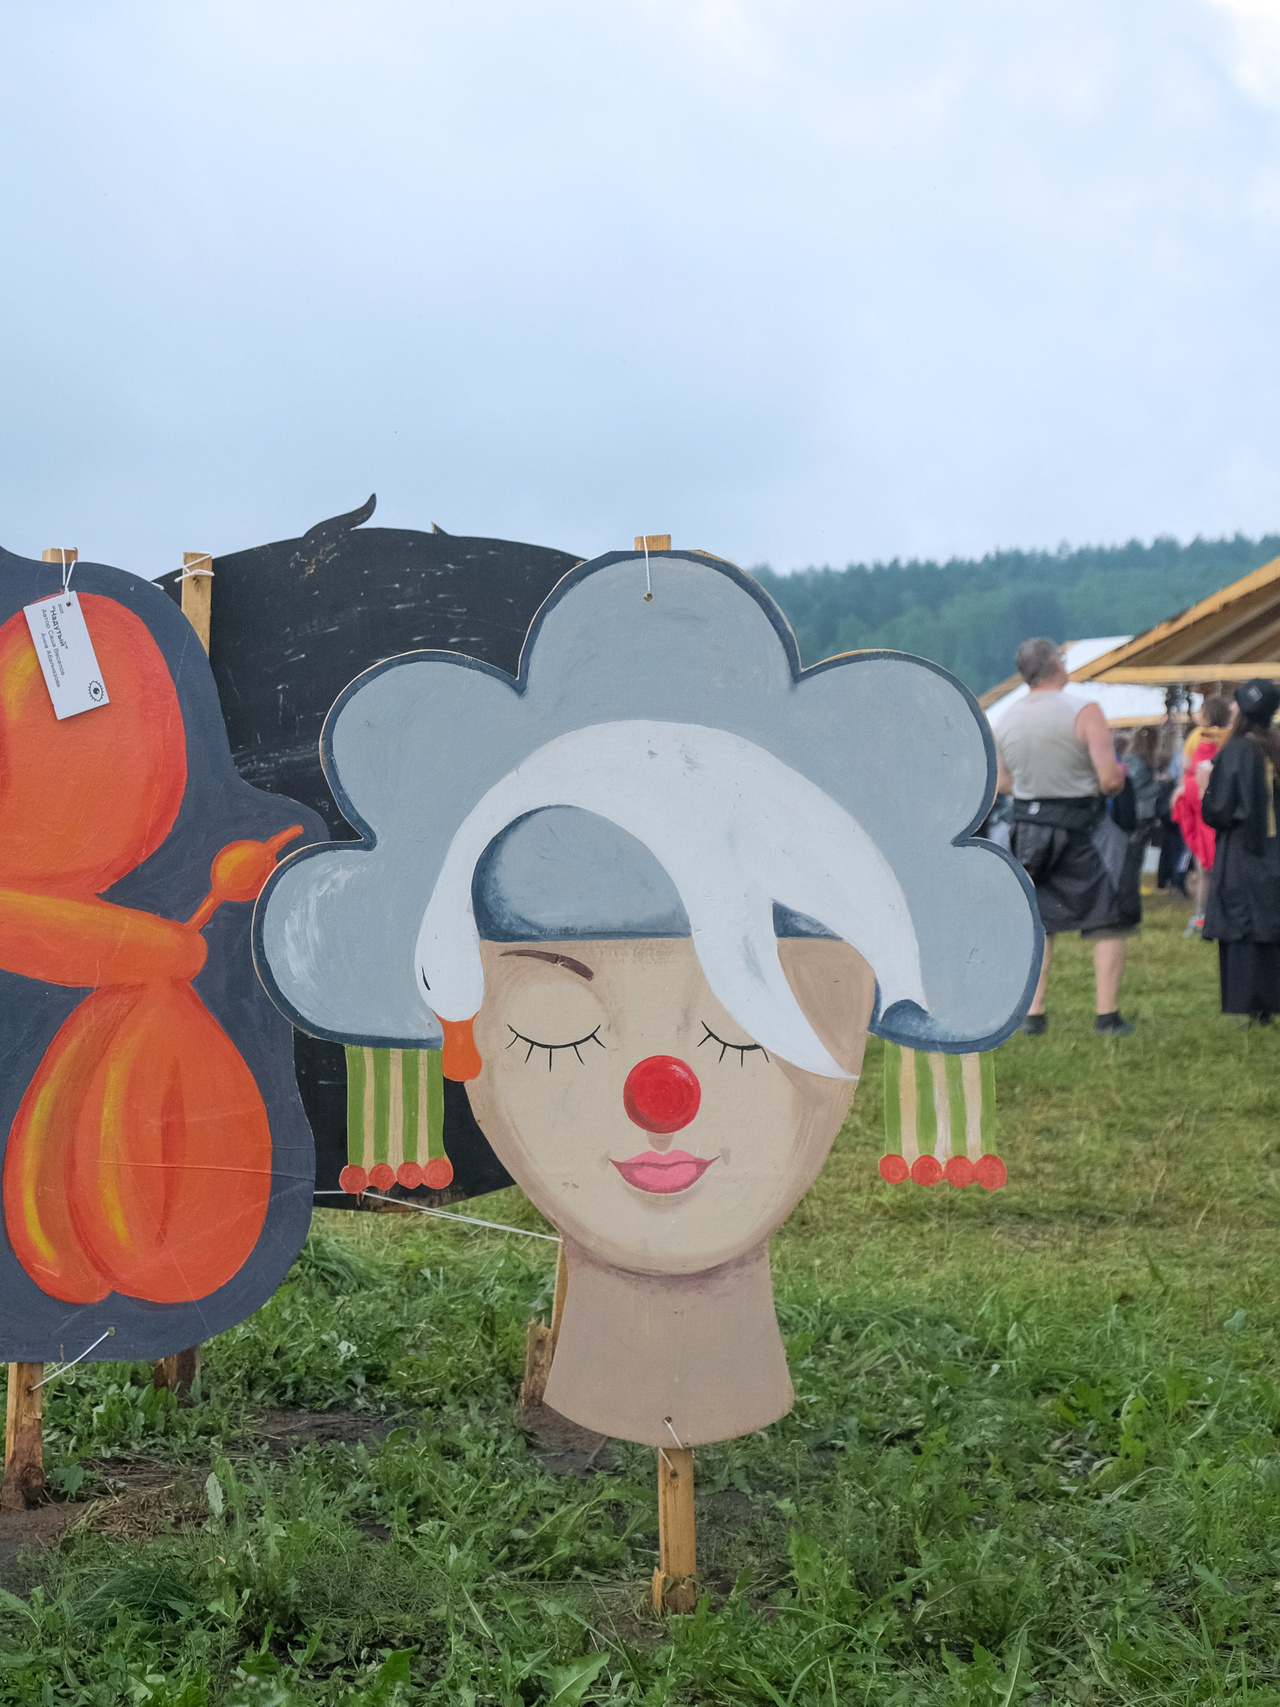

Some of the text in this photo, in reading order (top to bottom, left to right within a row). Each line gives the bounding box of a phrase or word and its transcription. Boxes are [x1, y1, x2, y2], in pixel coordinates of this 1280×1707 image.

[41, 609, 65, 676] Автор Саша Веселов
